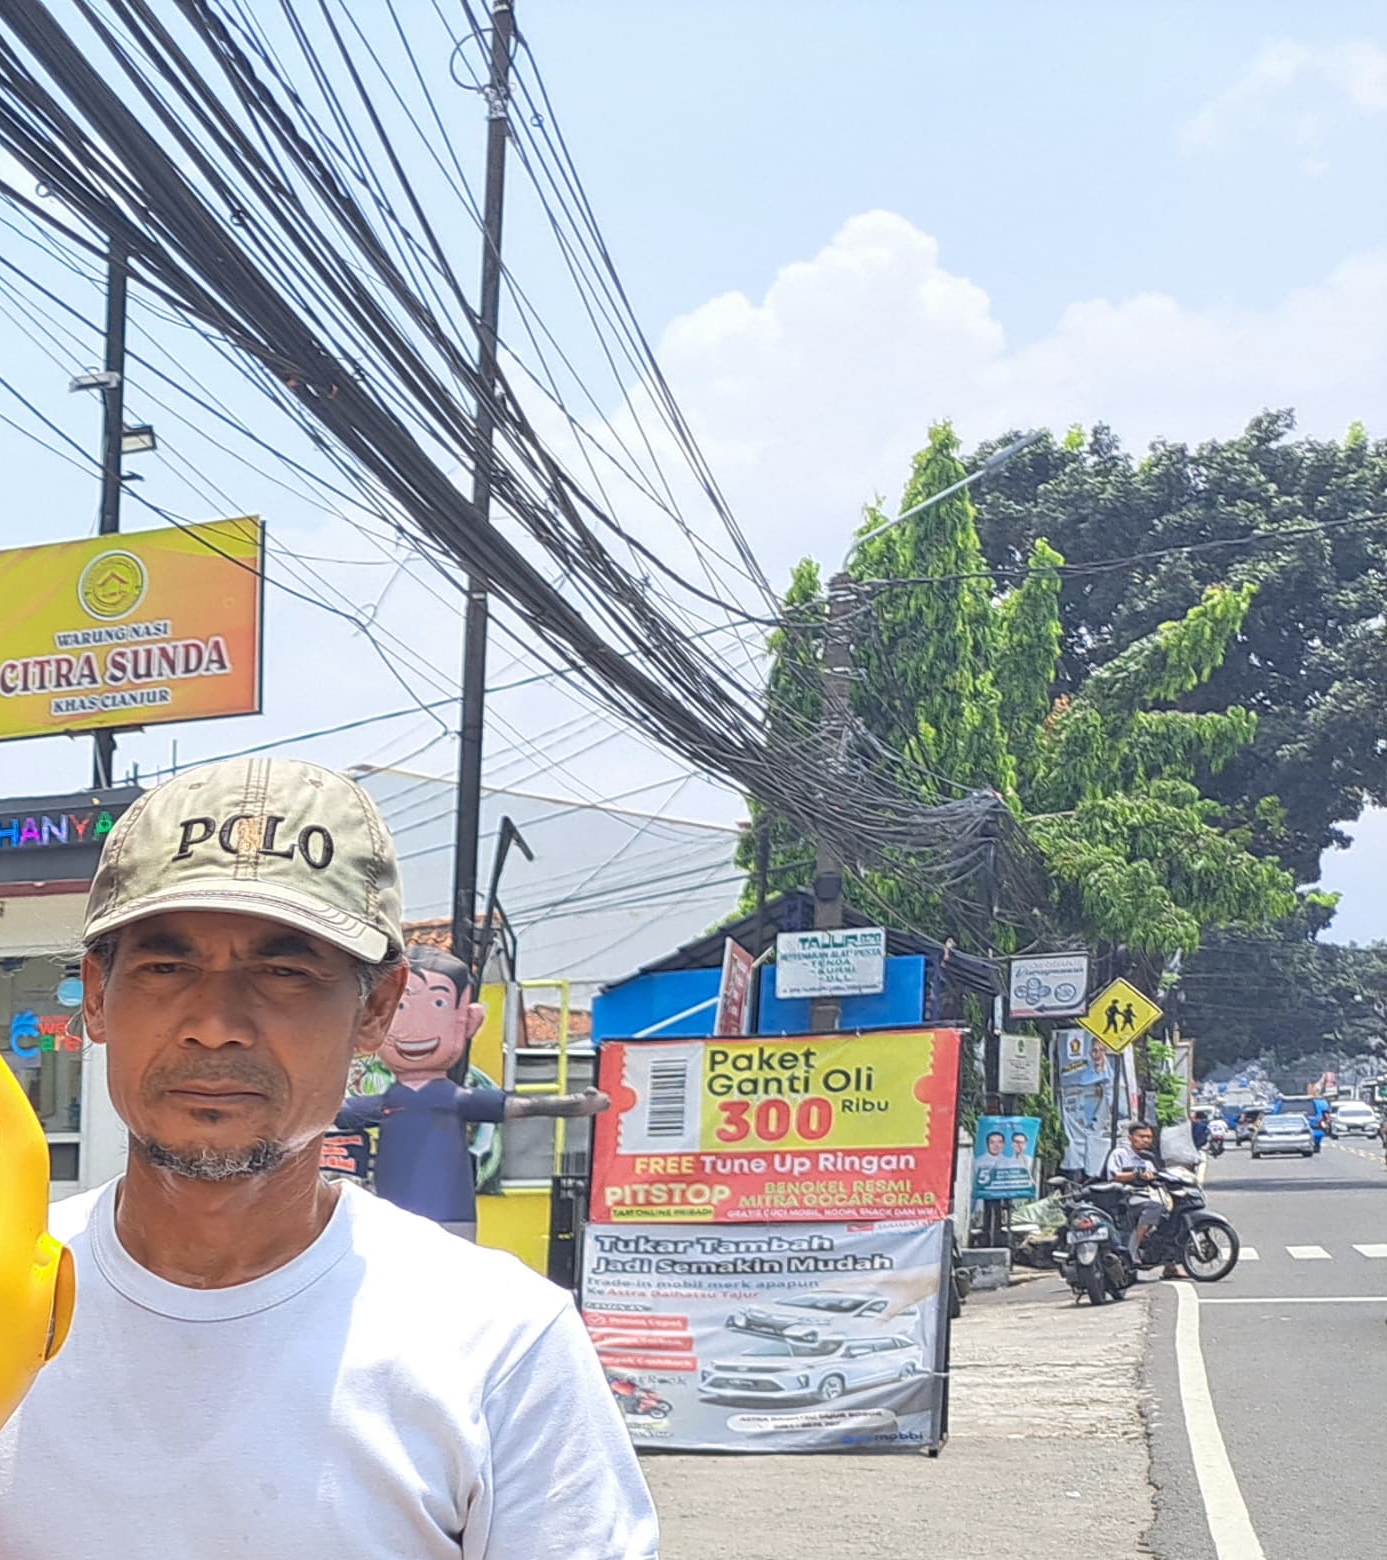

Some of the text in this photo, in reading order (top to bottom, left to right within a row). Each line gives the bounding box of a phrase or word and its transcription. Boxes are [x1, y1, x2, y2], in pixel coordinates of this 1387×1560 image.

[57, 622, 169, 647] WARUNG NASI
[108, 639, 228, 683] SUNDA
[53, 698, 98, 714] KHAS
[172, 815, 334, 870] POLO
[709, 1047, 816, 1072] Paket
[707, 1066, 874, 1096] Ganti Oli
[715, 1097, 889, 1143] 300 Ribu
[635, 1152, 916, 1176] FREE Tune Up Ringan
[605, 1183, 731, 1207] PITSTOP
[765, 1179, 911, 1195] BENGKEL RESMI
[738, 1194, 800, 1208] MITRA
[595, 1234, 834, 1254] Tukar Tambah
[593, 1253, 894, 1275] Jadi Semakin Mudah
